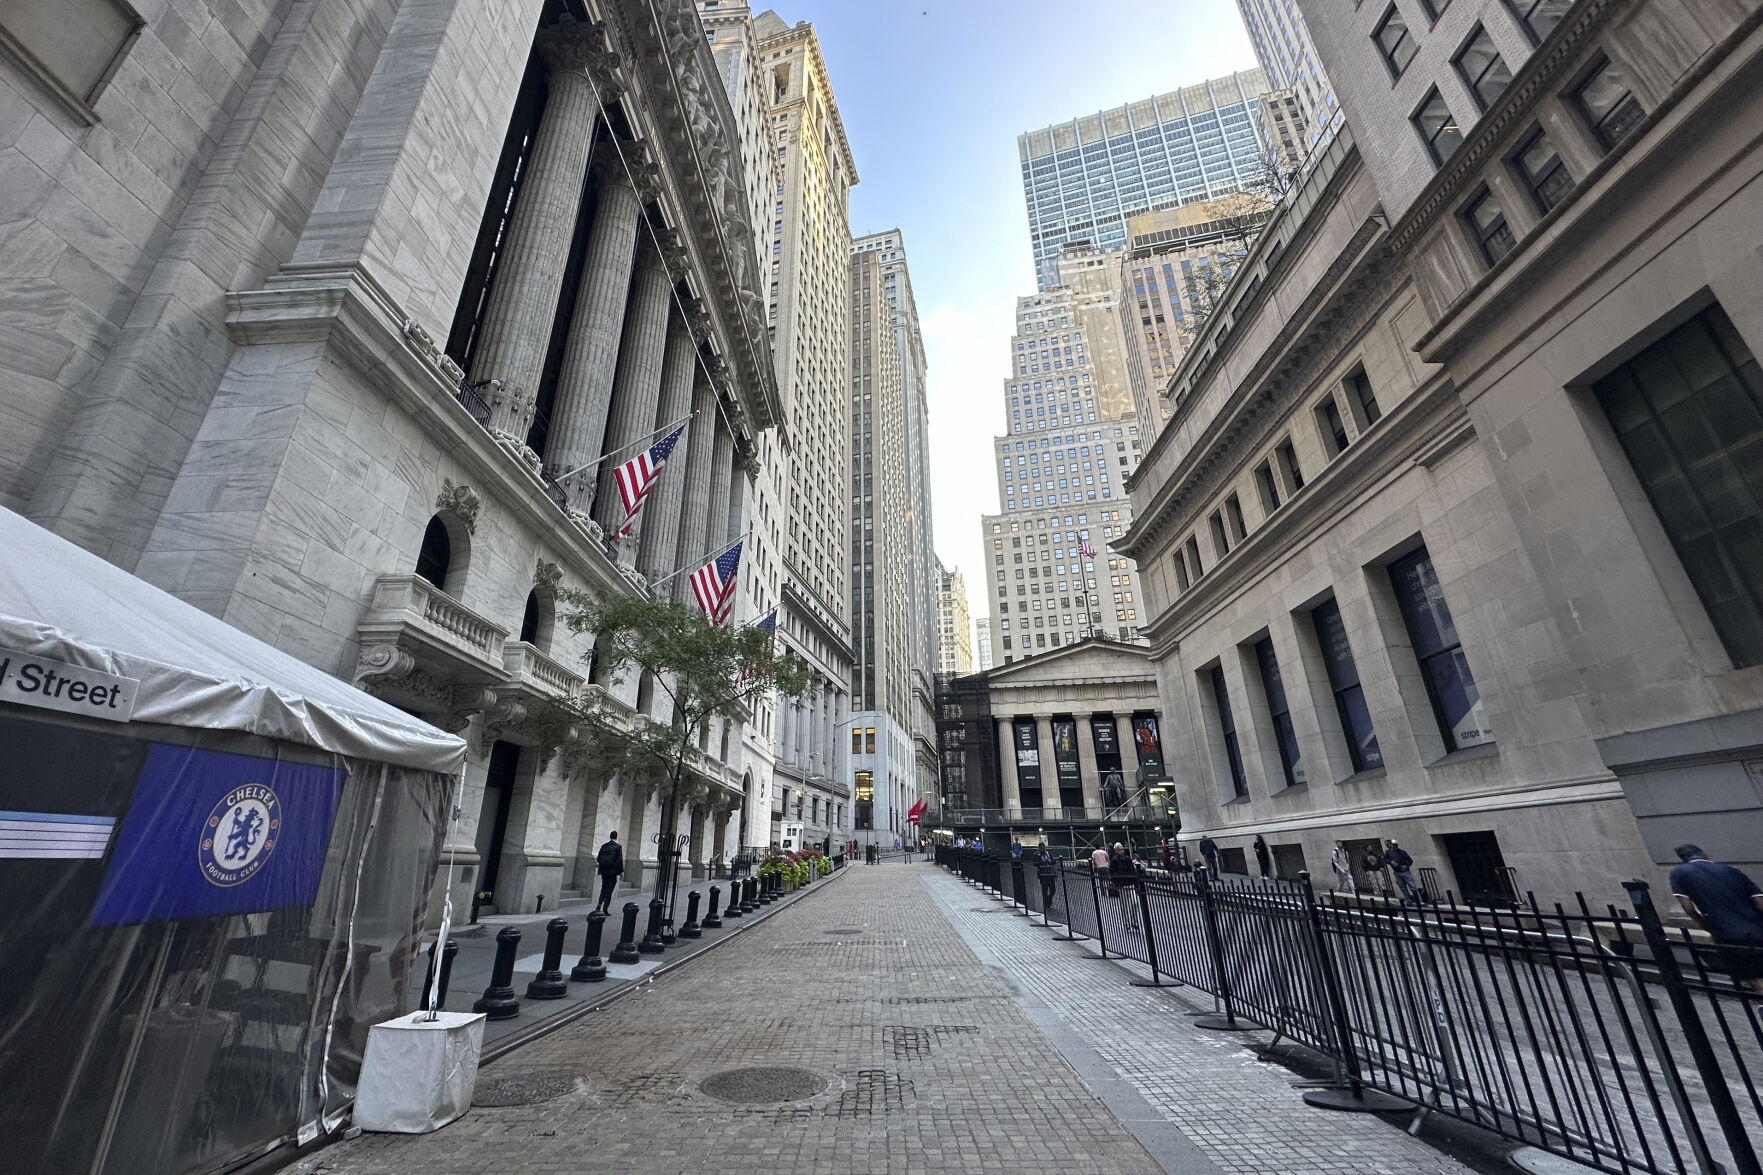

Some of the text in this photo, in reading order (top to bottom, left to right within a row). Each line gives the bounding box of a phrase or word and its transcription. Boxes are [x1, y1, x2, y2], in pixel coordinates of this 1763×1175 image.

[16, 663, 121, 709] Street
[1460, 728, 1481, 740] stripe
[226, 786, 275, 810] CHELSEA
[206, 860, 259, 881] FOOTBALL CLUB
